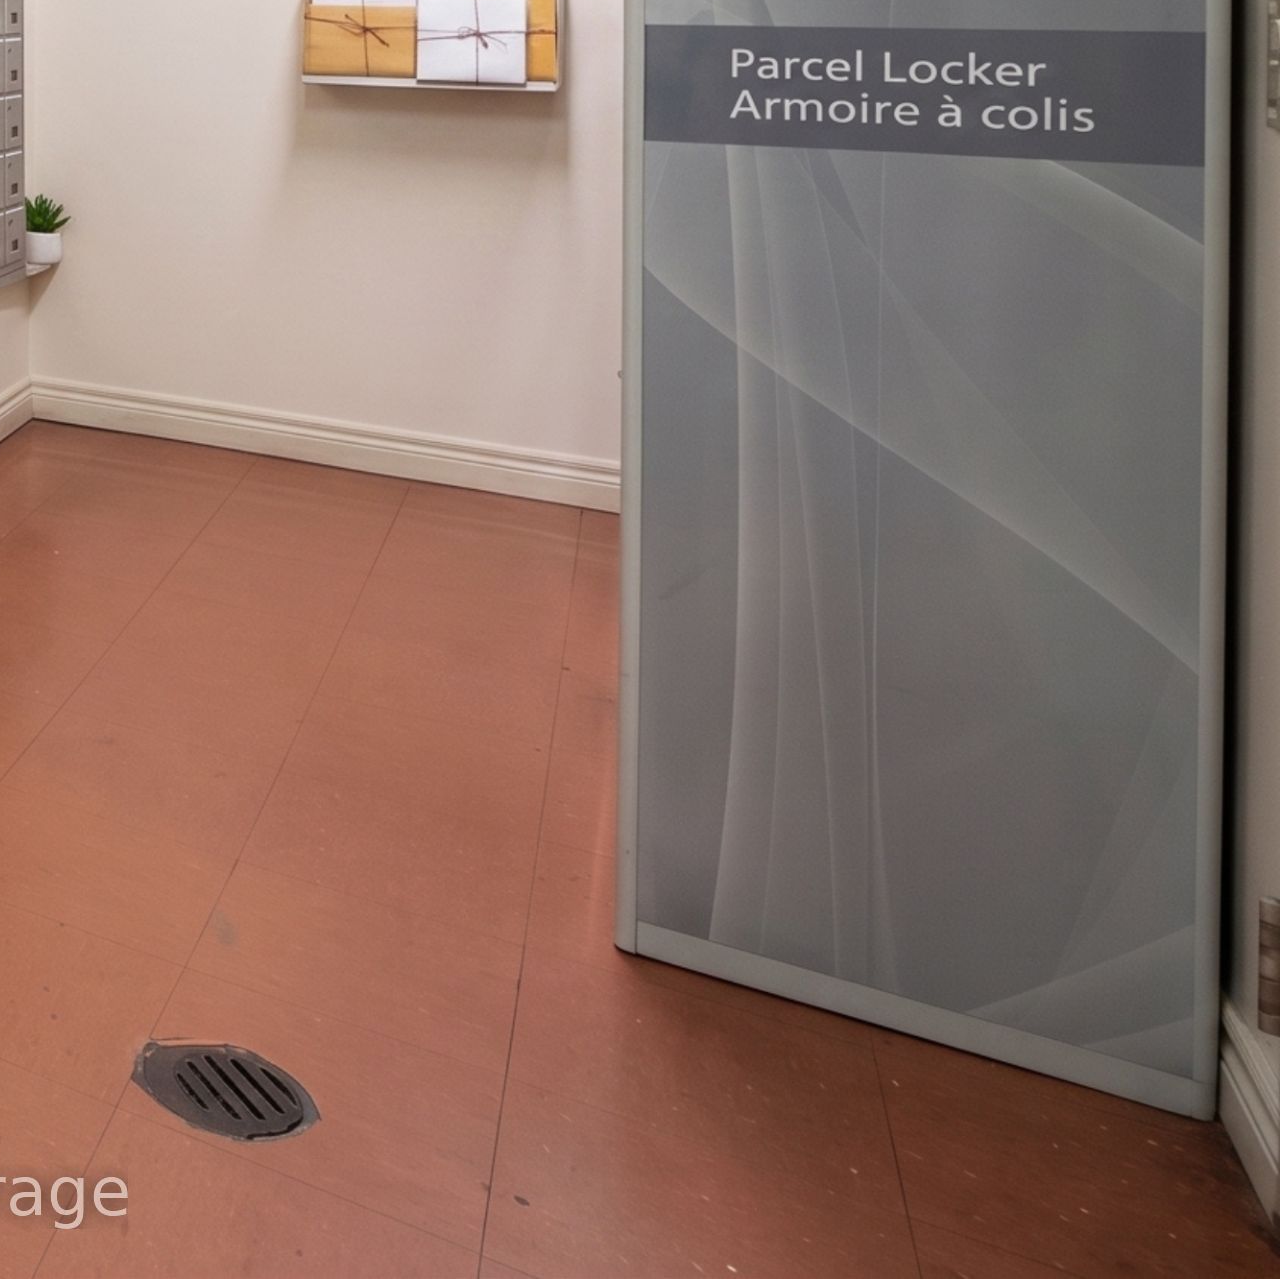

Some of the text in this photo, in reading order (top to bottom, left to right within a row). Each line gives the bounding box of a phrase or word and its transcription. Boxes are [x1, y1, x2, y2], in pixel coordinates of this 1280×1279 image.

[730, 48, 1046, 88] Parcel Locker
[729, 90, 1096, 134] Armoire à colis
